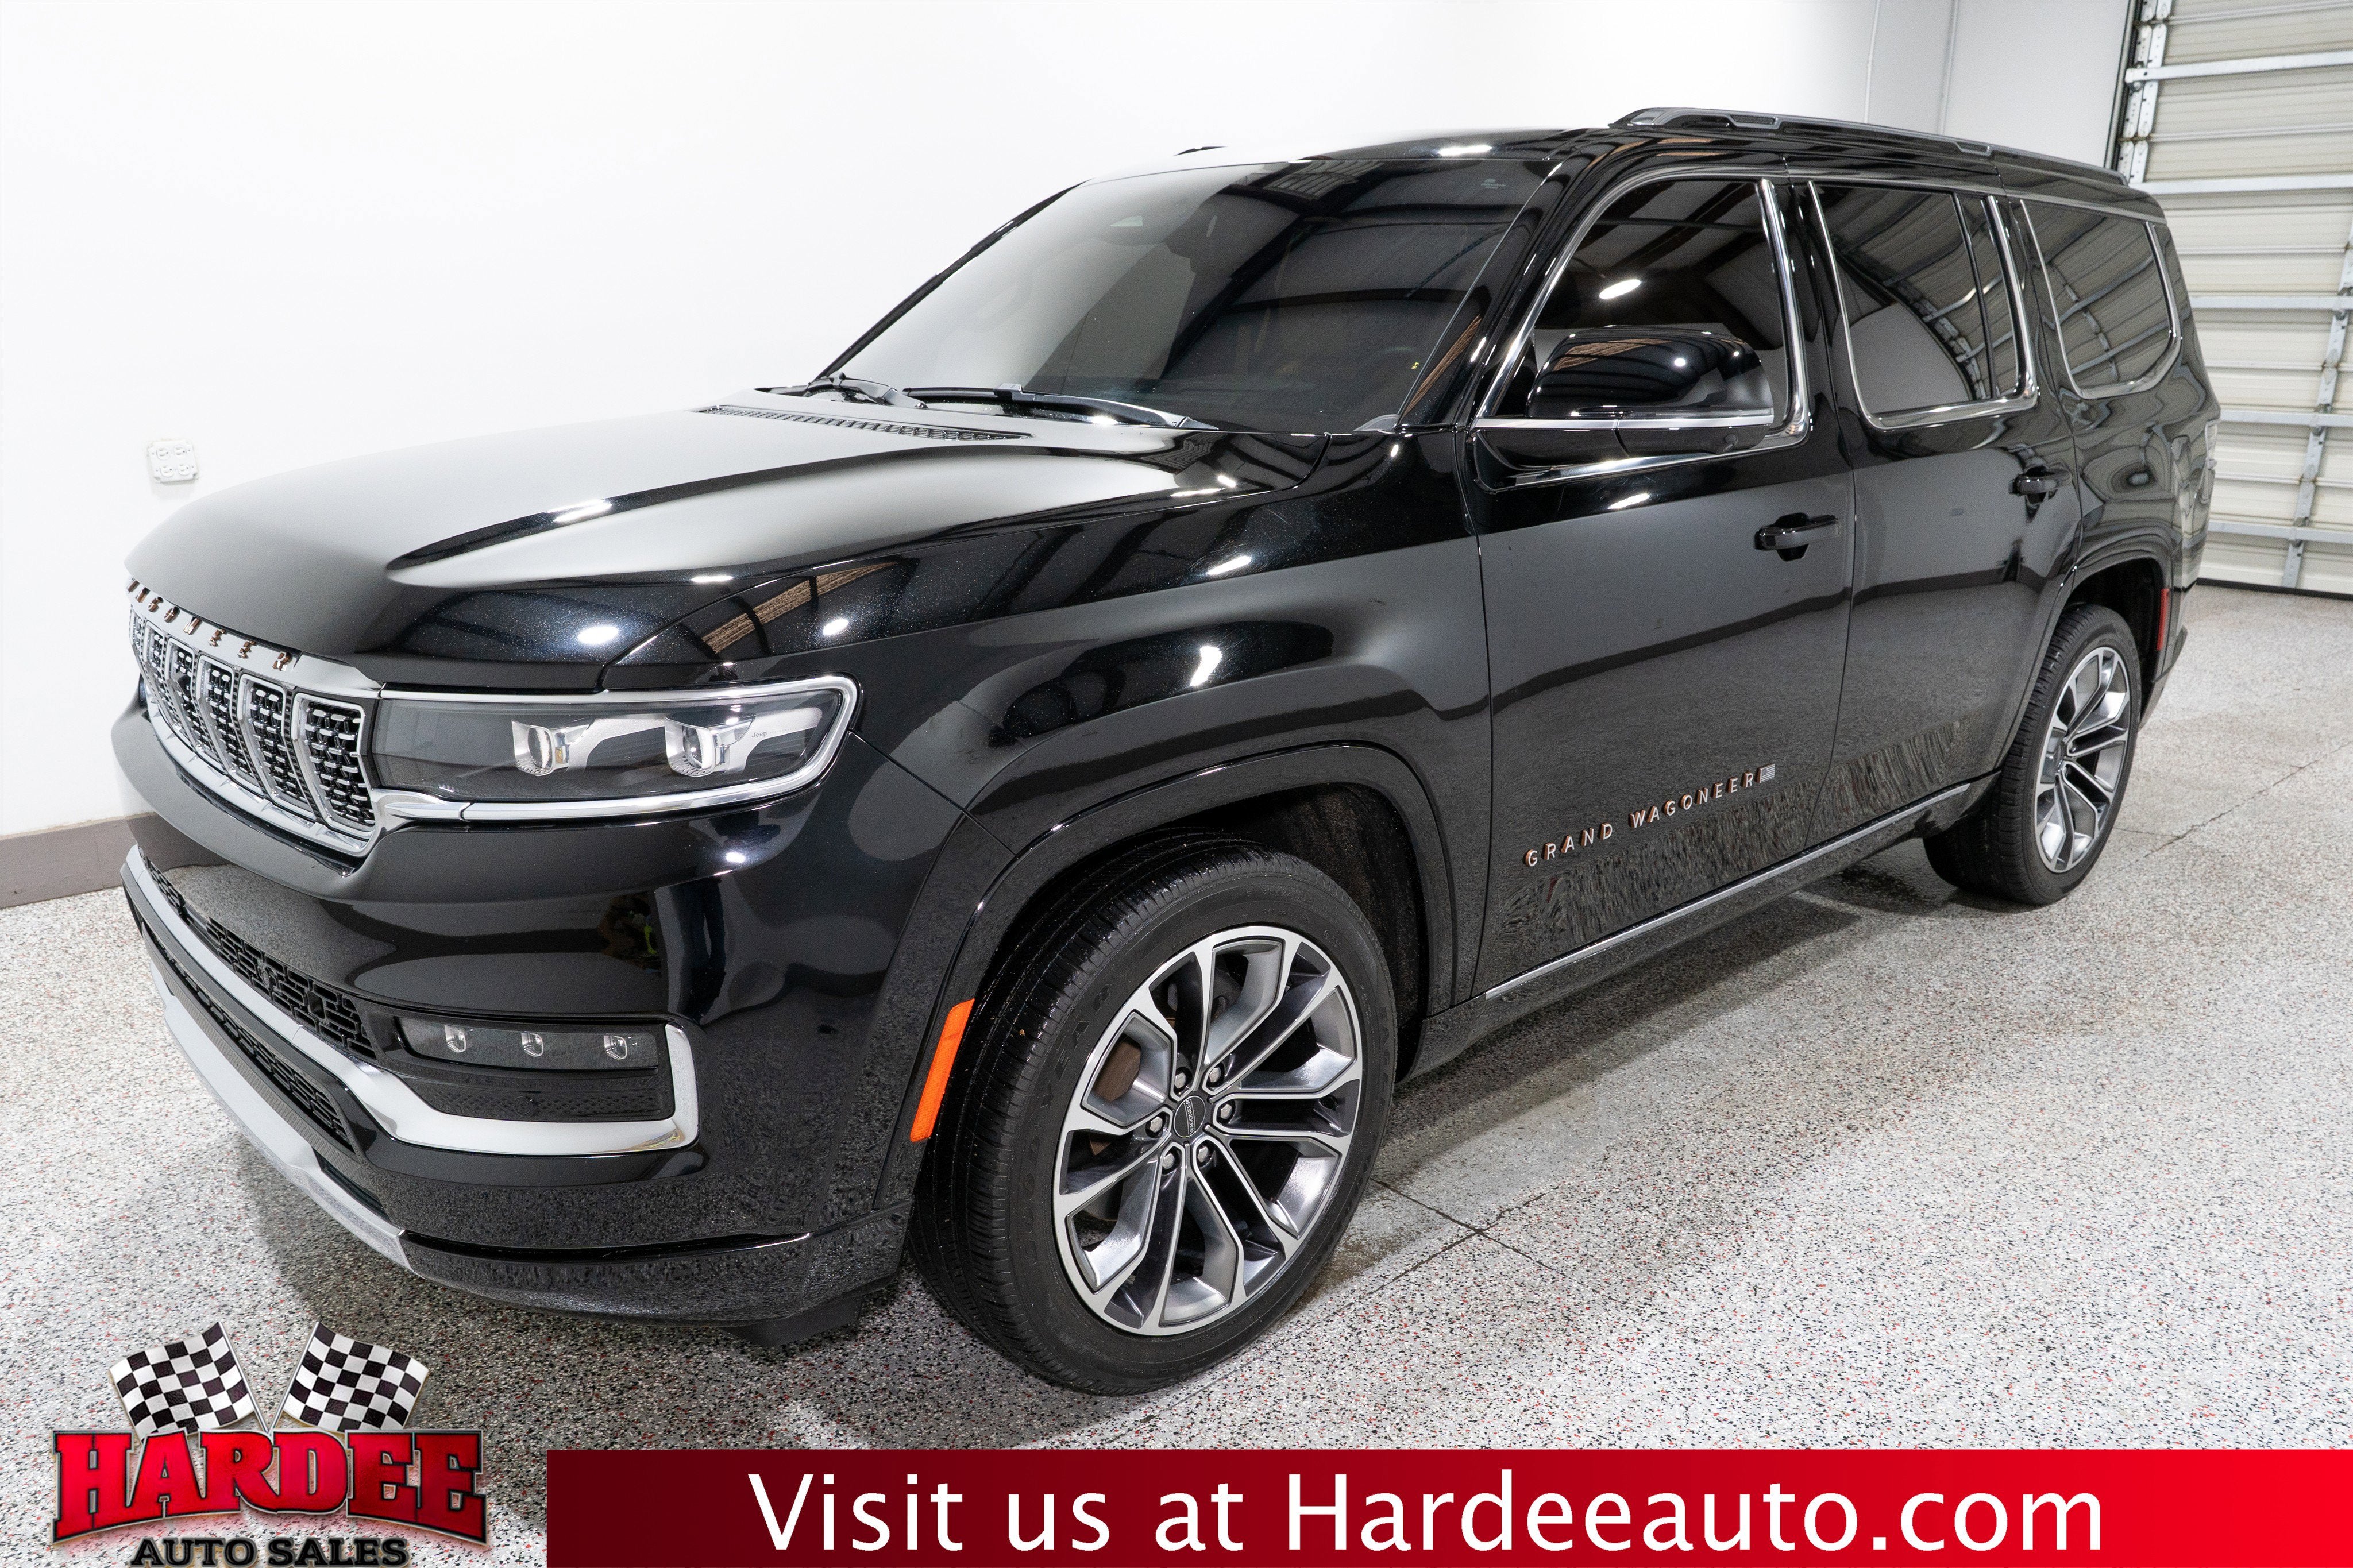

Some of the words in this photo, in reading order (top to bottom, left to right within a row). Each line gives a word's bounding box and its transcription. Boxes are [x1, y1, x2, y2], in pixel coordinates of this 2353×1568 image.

[1526, 822, 1613, 867] GRAND
[1629, 772, 1754, 828] WAGONEER
[1185, 1098, 1195, 1135] WAGONEER
